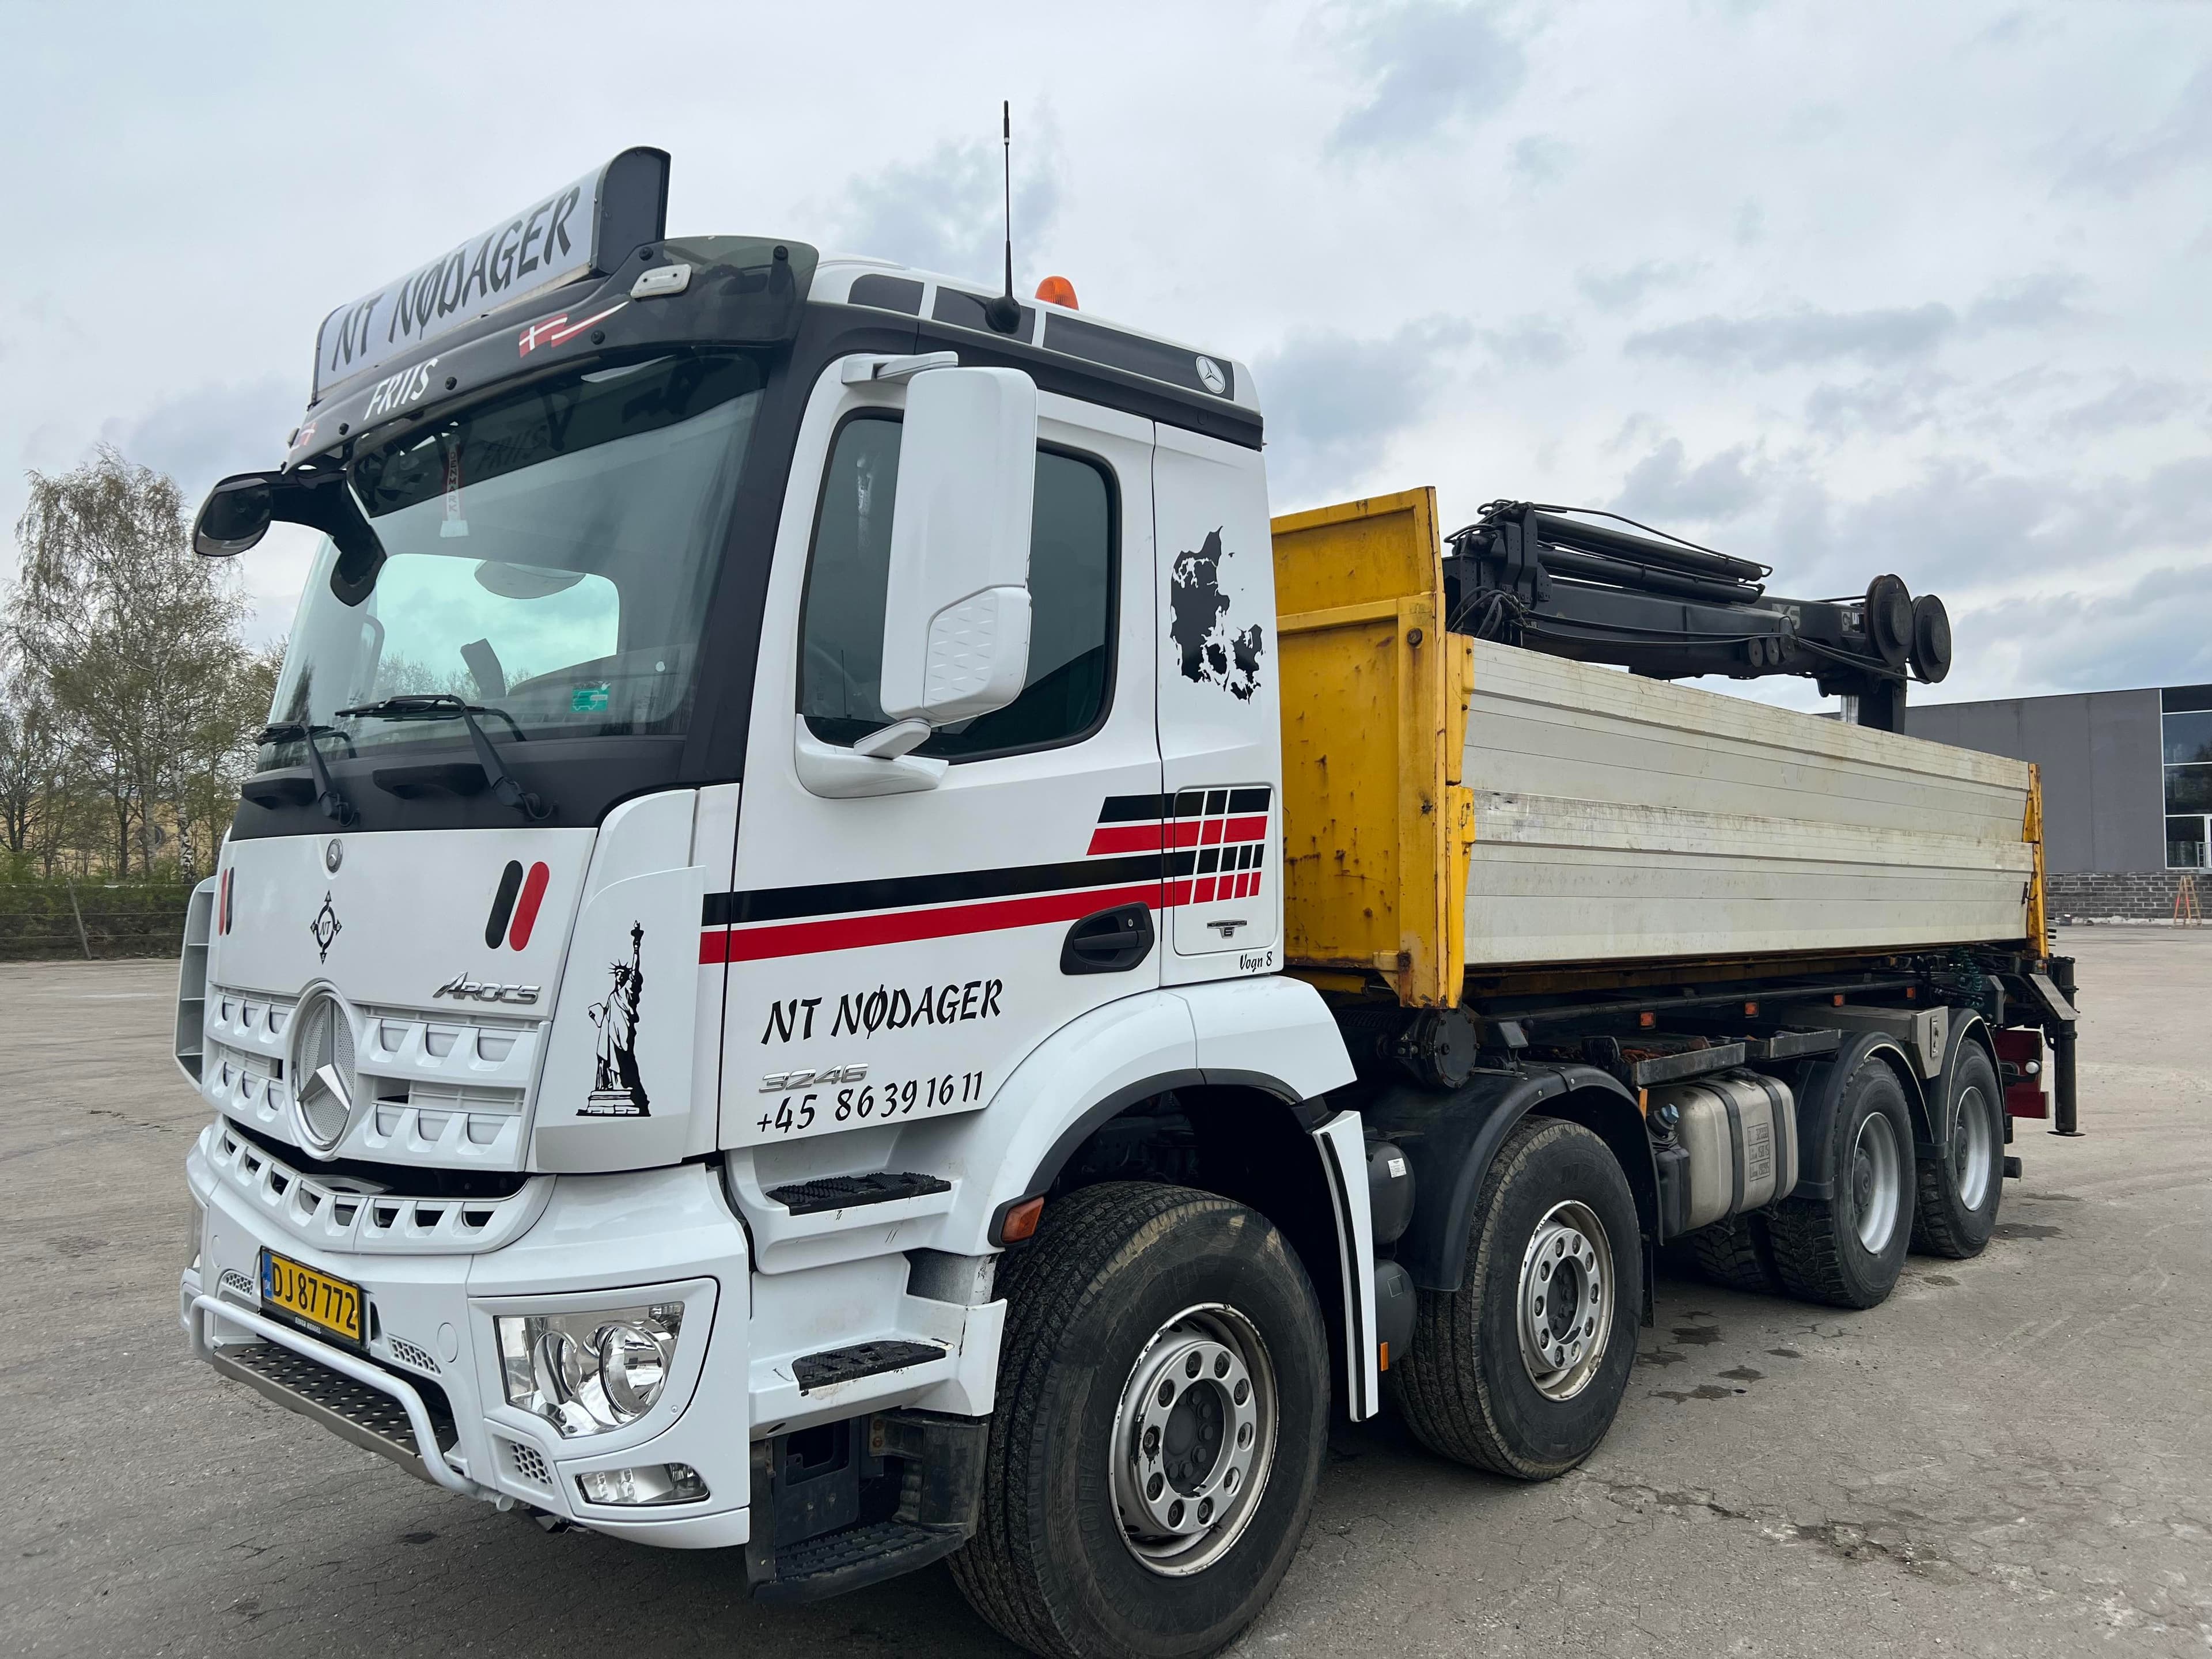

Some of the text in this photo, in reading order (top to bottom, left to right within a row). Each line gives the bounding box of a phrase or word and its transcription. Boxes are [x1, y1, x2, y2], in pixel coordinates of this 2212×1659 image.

[331, 186, 581, 372] NT NØDAGER
[363, 358, 440, 421] FRIIS
[449, 452, 457, 512] DENMARK
[320, 921, 331, 935] NT
[1240, 951, 1272, 972] Vogn 8
[761, 979, 1003, 1046] NT NØDAGER
[759, 1063, 869, 1093] 3246
[757, 1094, 818, 1133] +45
[272, 1262, 293, 1302] DJ
